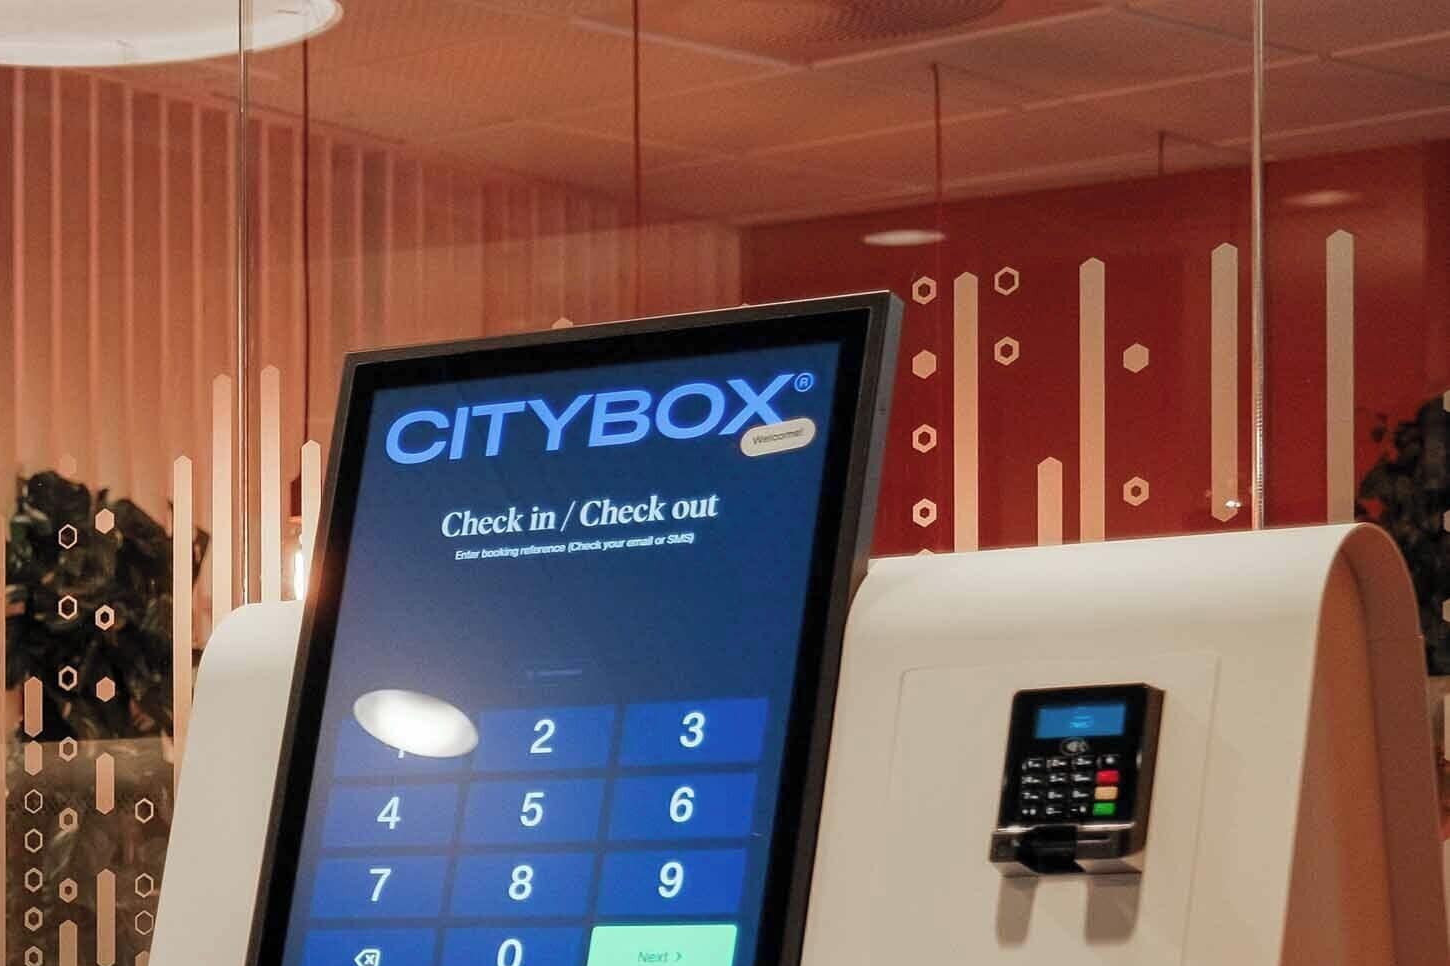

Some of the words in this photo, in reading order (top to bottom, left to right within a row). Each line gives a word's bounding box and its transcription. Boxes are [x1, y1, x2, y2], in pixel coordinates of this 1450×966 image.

[441, 507, 524, 537] Check
[528, 506, 556, 531] in
[579, 495, 666, 527] Check
[671, 494, 720, 520] out
[455, 550, 480, 560] Enter
[481, 547, 519, 558] booking
[602, 540, 625, 551] your
[626, 535, 654, 547] email
[655, 536, 666, 545] or
[529, 719, 556, 754] 2
[678, 712, 705, 748] 3
[377, 796, 402, 830] 4
[520, 792, 545, 827] 5
[669, 786, 695, 822] 6
[368, 868, 392, 902] 7
[508, 865, 534, 901] 8
[658, 861, 684, 899] 9
[638, 951, 669, 963] Next
